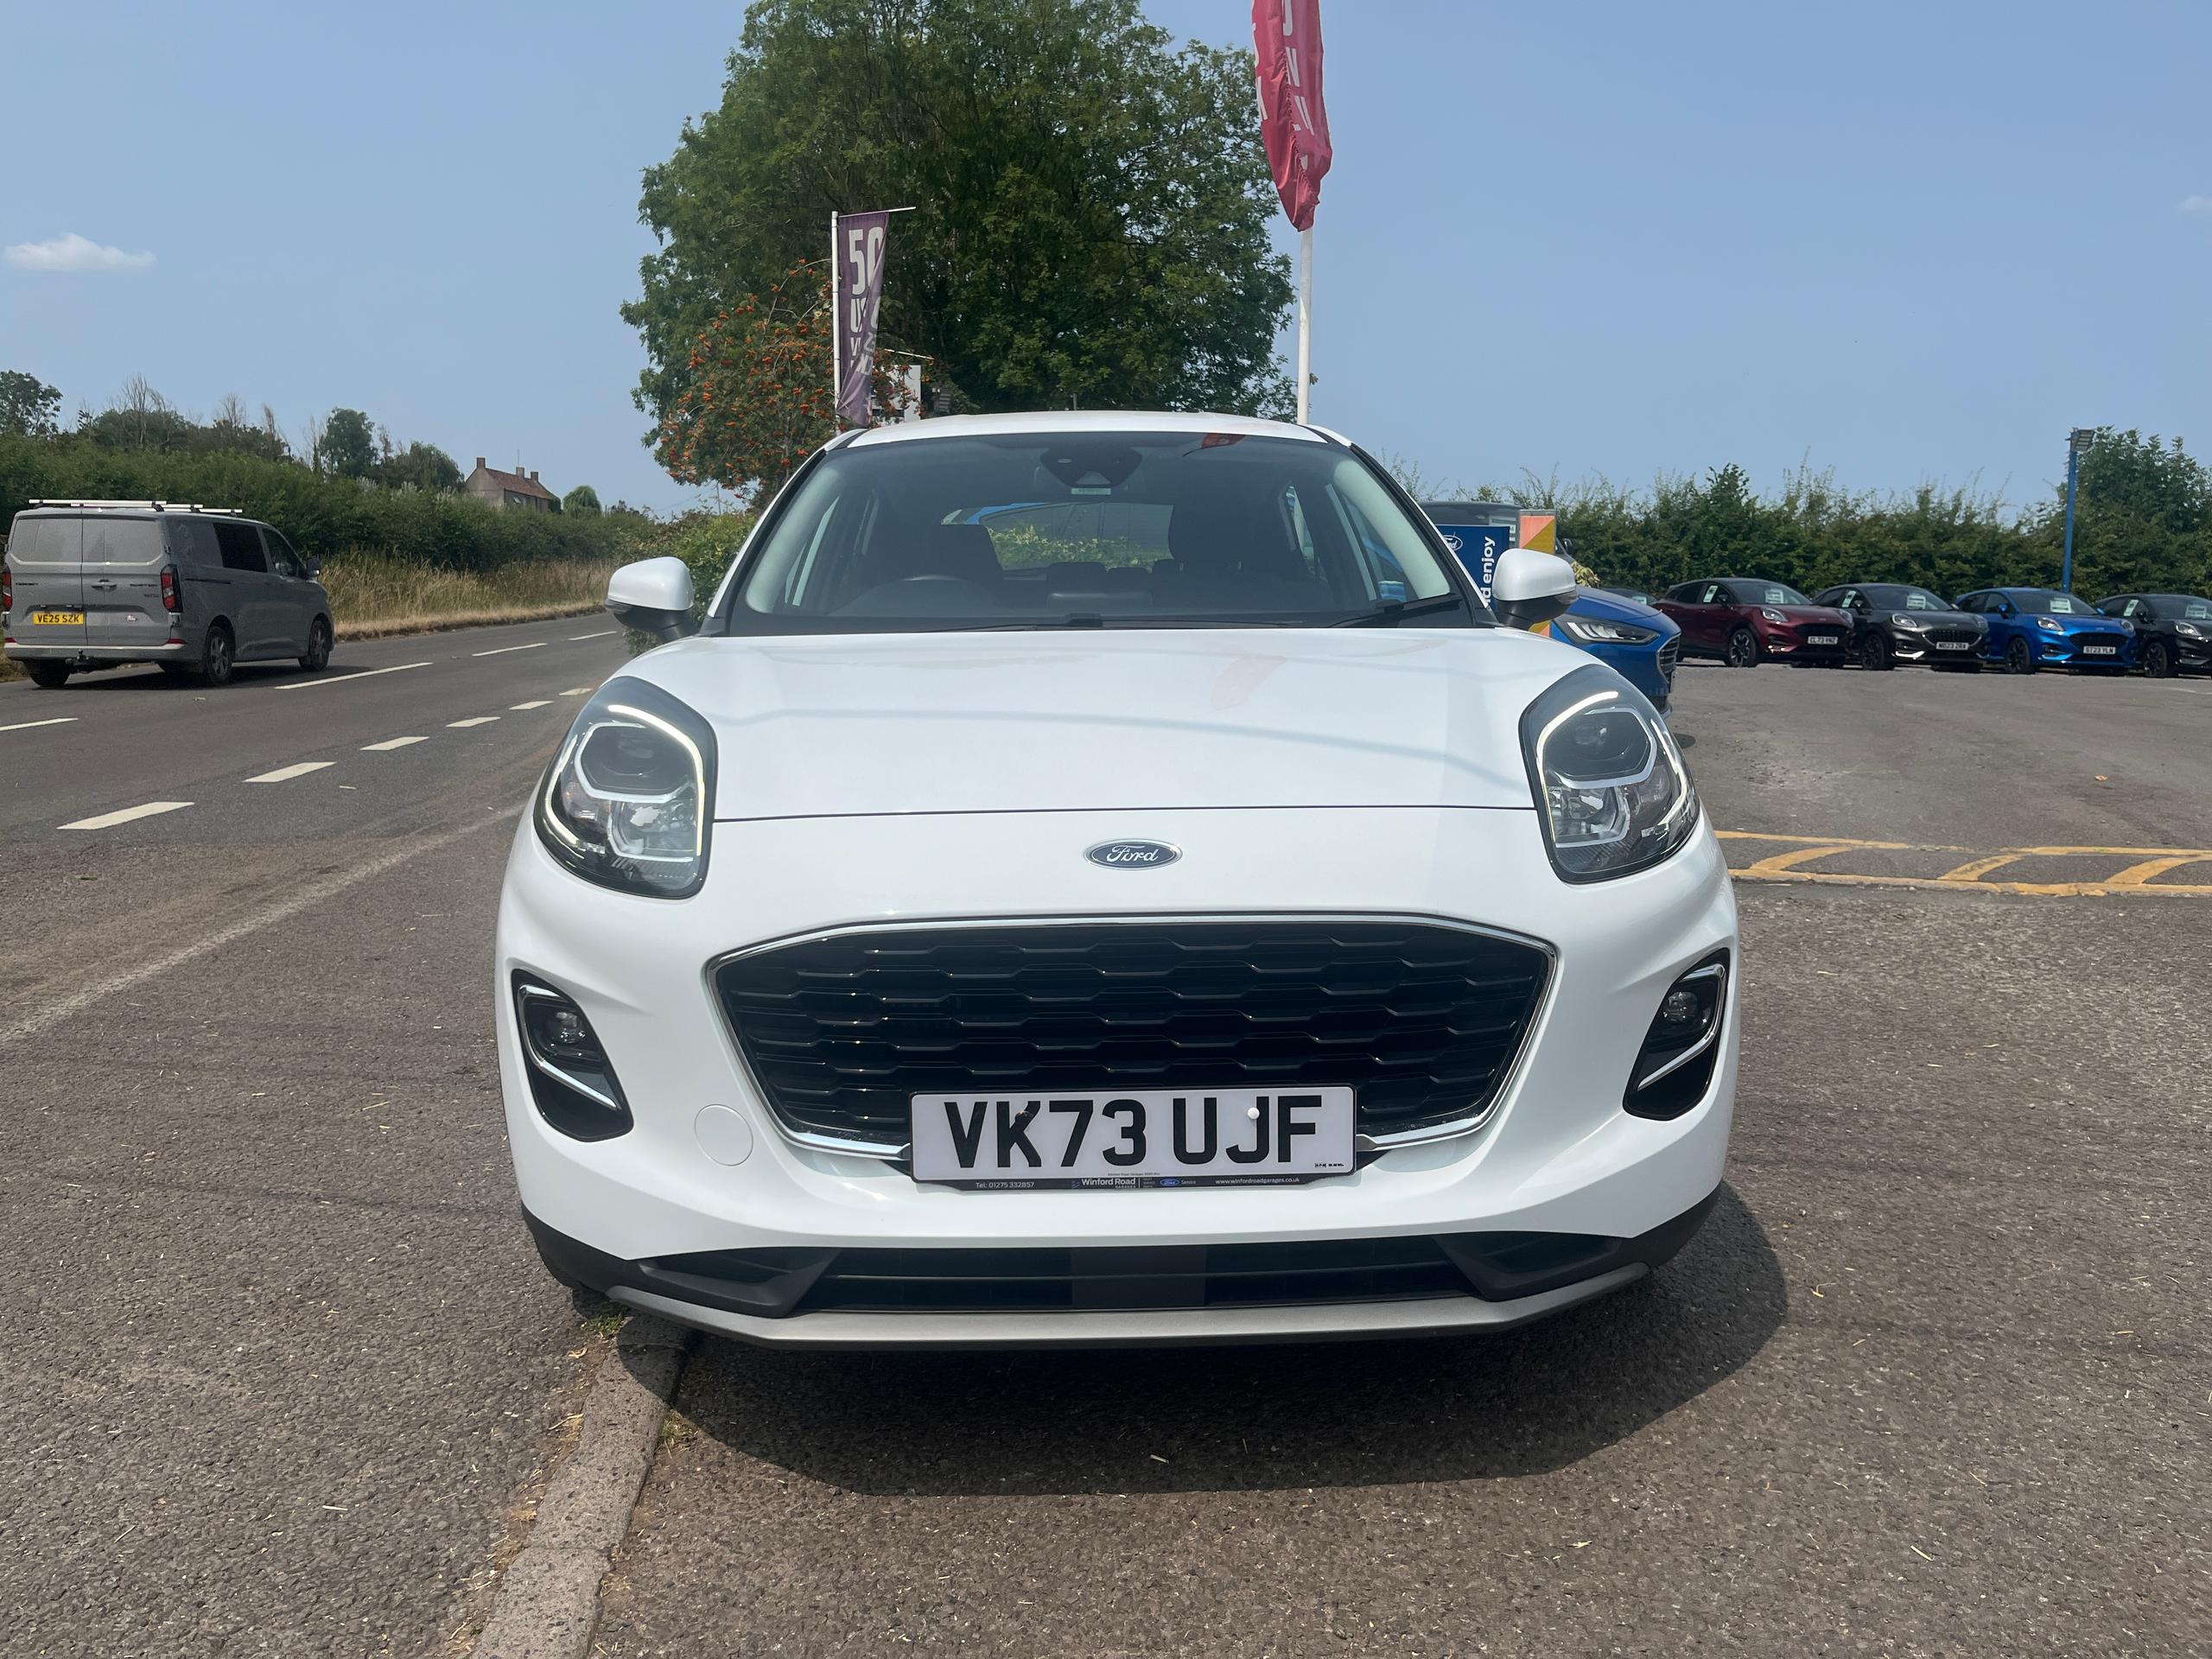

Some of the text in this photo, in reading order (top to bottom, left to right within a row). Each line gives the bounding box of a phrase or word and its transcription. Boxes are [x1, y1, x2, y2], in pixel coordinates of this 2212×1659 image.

[1482, 536, 1496, 583] enjoy
[37, 614, 79, 623] VE25 SZK
[1106, 844, 1160, 862] Ford
[944, 1095, 1322, 1168] VK73 UJF
[1081, 1177, 1114, 1185] Winford
[1115, 1177, 1136, 1185] Road
